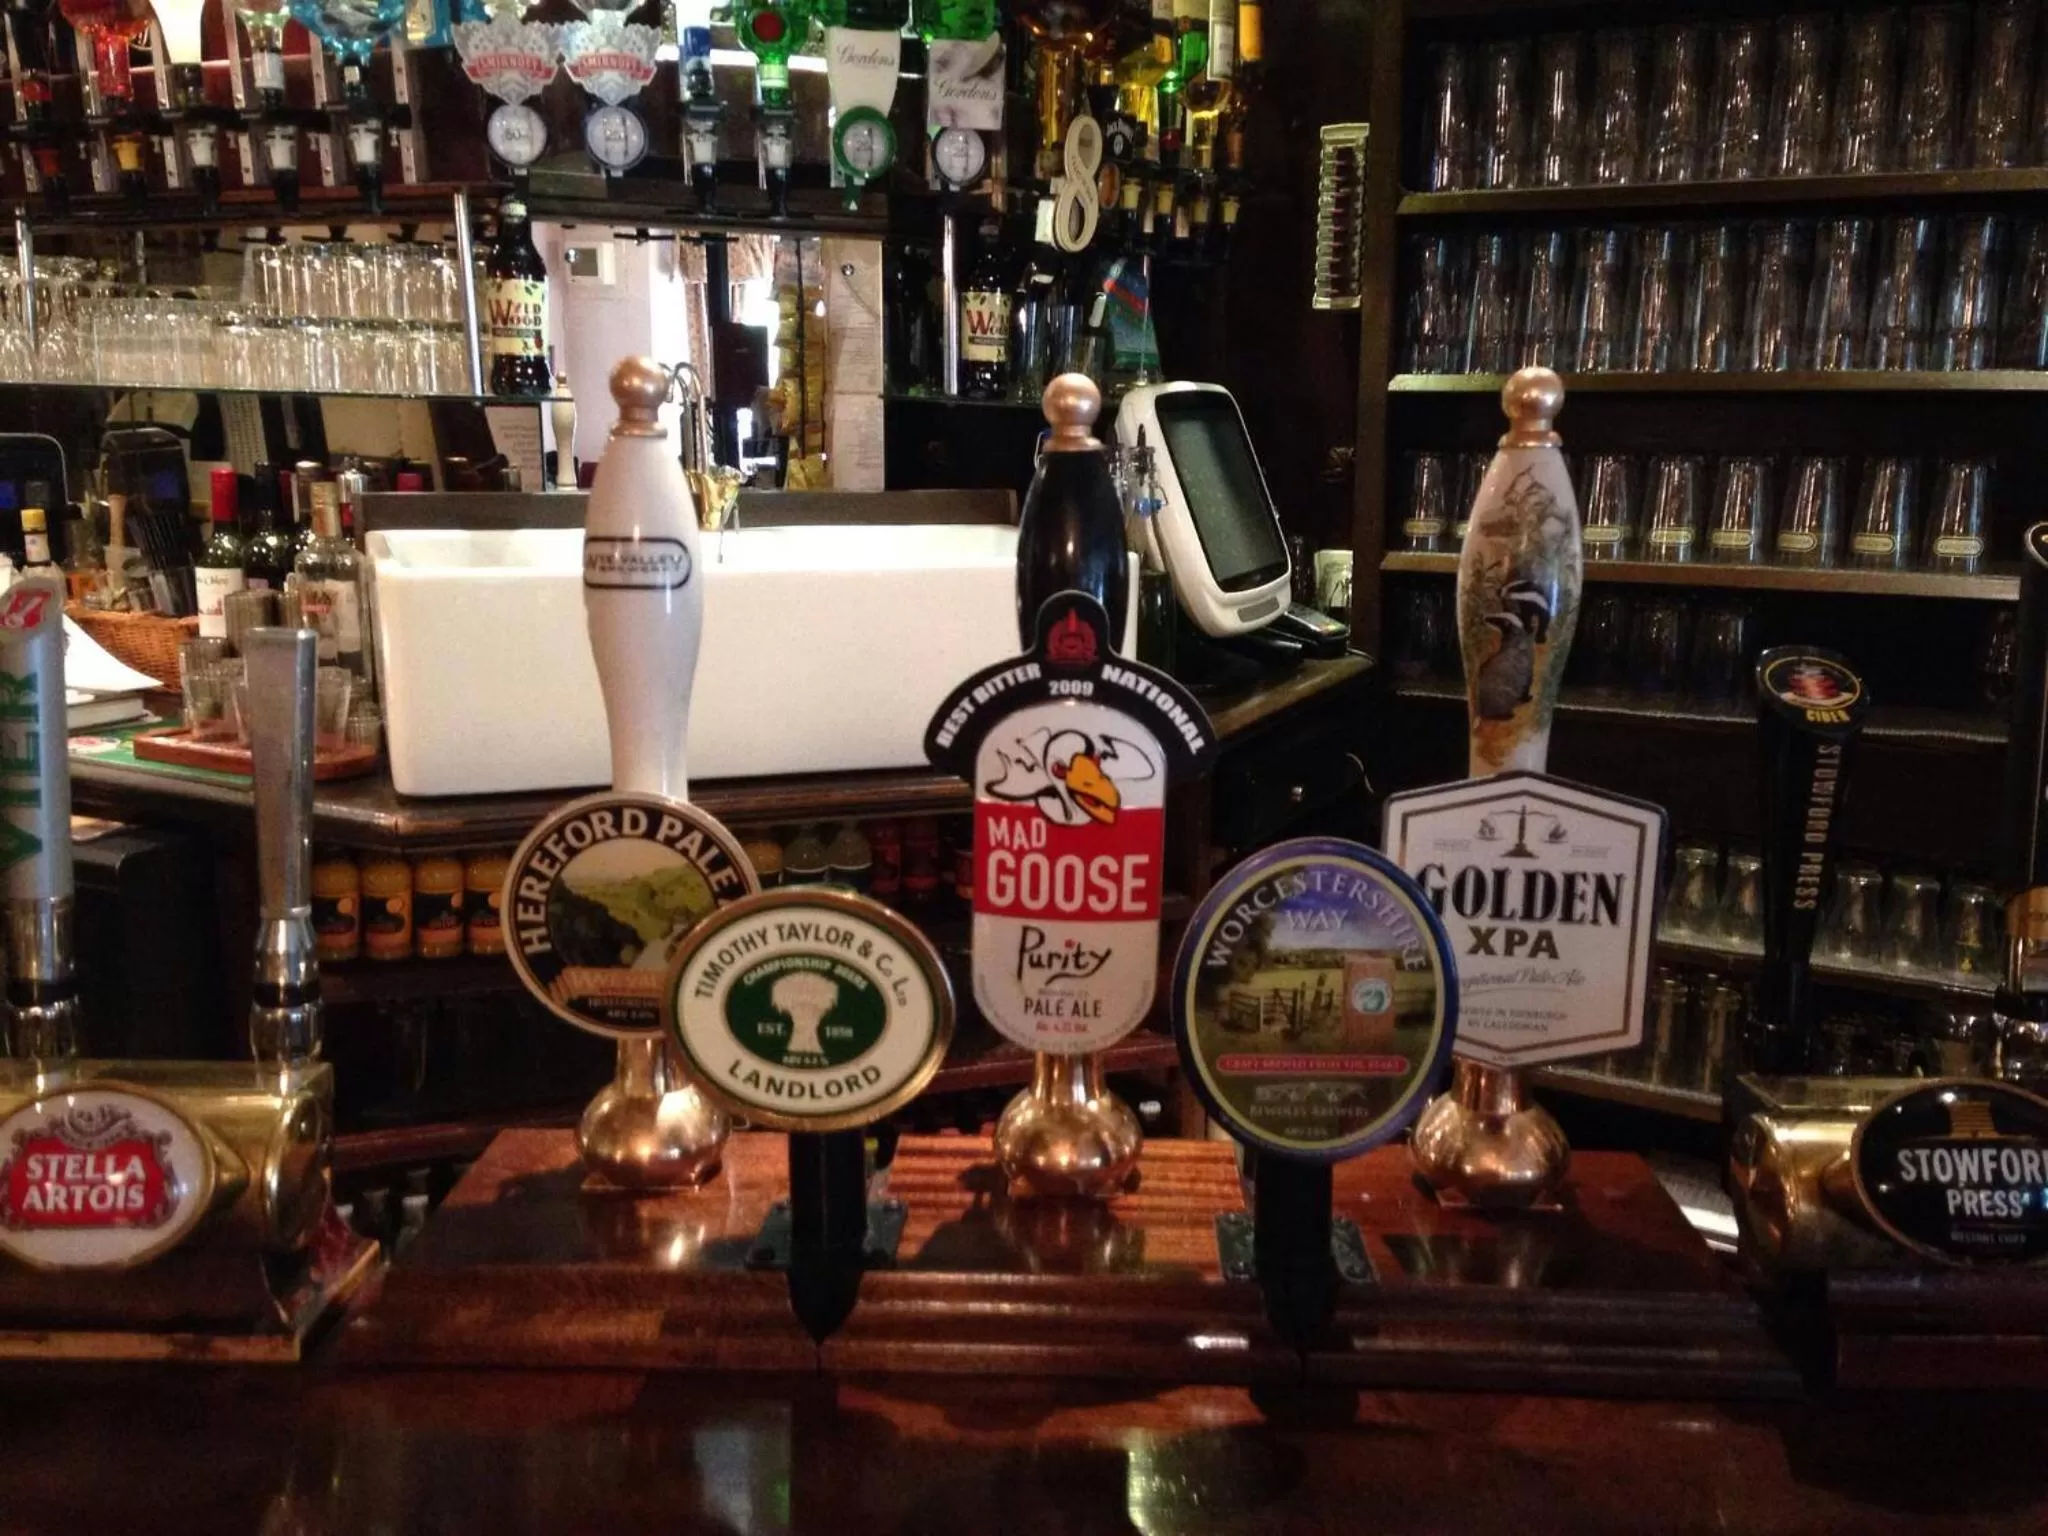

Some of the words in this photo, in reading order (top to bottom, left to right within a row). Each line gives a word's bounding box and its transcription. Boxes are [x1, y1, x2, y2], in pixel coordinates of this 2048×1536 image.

[935, 696, 978, 750] BEST
[973, 662, 1042, 705] BITTER
[1049, 681, 1095, 697] 2009
[1101, 663, 1206, 756] NATIONAL
[987, 815, 1048, 851] MAD
[517, 807, 648, 955] HEREFORD
[655, 813, 739, 894] PALE
[986, 850, 1150, 914] GOOSE
[1415, 862, 1627, 926] GOLDEN
[1793, 851, 1825, 911] PRESS
[1206, 869, 1426, 971] WORCESTERSHIRE
[1286, 908, 1348, 931] WAY
[694, 922, 768, 999] TIMOTHY
[774, 921, 855, 951] TAYLOR
[856, 939, 873, 959] &
[1016, 924, 1112, 985] Purity
[1466, 925, 1561, 960] XPA
[743, 956, 832, 987] CHAMPIONSHIP
[1024, 995, 1064, 1018] PALE
[1071, 998, 1102, 1019] ALE
[728, 1058, 882, 1099] LANDLORD
[26, 1153, 146, 1182] STELLA
[22, 1183, 145, 1213] ARTOIS
[1946, 1188, 2024, 1218] PRESS
